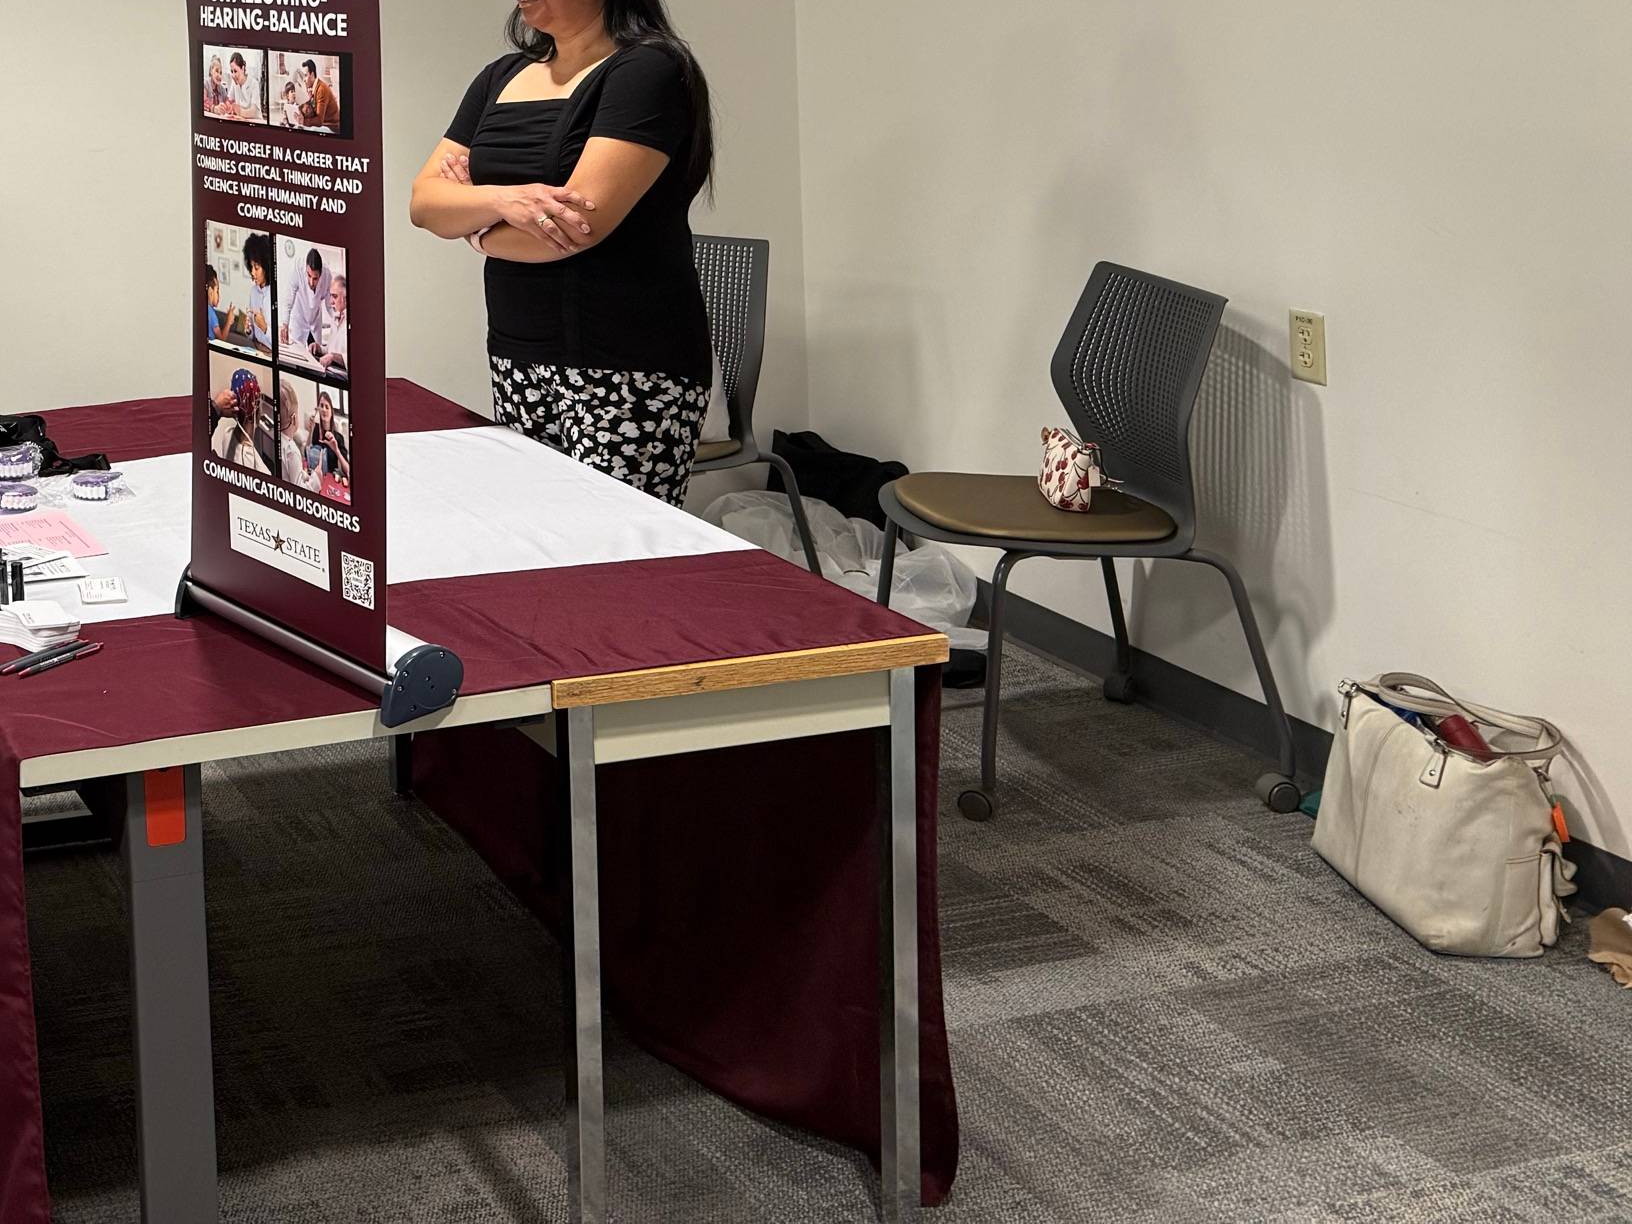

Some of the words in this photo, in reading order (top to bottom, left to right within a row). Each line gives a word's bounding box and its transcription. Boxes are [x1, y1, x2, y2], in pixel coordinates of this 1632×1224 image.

[200, 5, 348, 37] HEARING-BALANCE
[194, 133, 221, 152] PICTURE
[221, 138, 271, 158] YOURSELF
[272, 146, 283, 161] IN
[284, 148, 292, 163] A
[293, 150, 333, 169] CAREER
[335, 155, 370, 173] THAT
[196, 153, 236, 174] COMBINES
[238, 161, 282, 182] CRITICAL
[282, 168, 332, 190] THINKING
[334, 177, 363, 194] AND
[203, 176, 239, 195] SCIENCE
[240, 182, 266, 200] WITH
[268, 187, 318, 210] HUMANITY
[320, 197, 347, 214] AND
[237, 202, 303, 228] COMPASSION
[203, 459, 294, 507] COMMUNICATION
[295, 494, 360, 533] DISORDERS
[237, 516, 272, 542] TEXAS
[286, 537, 321, 564] STATE
